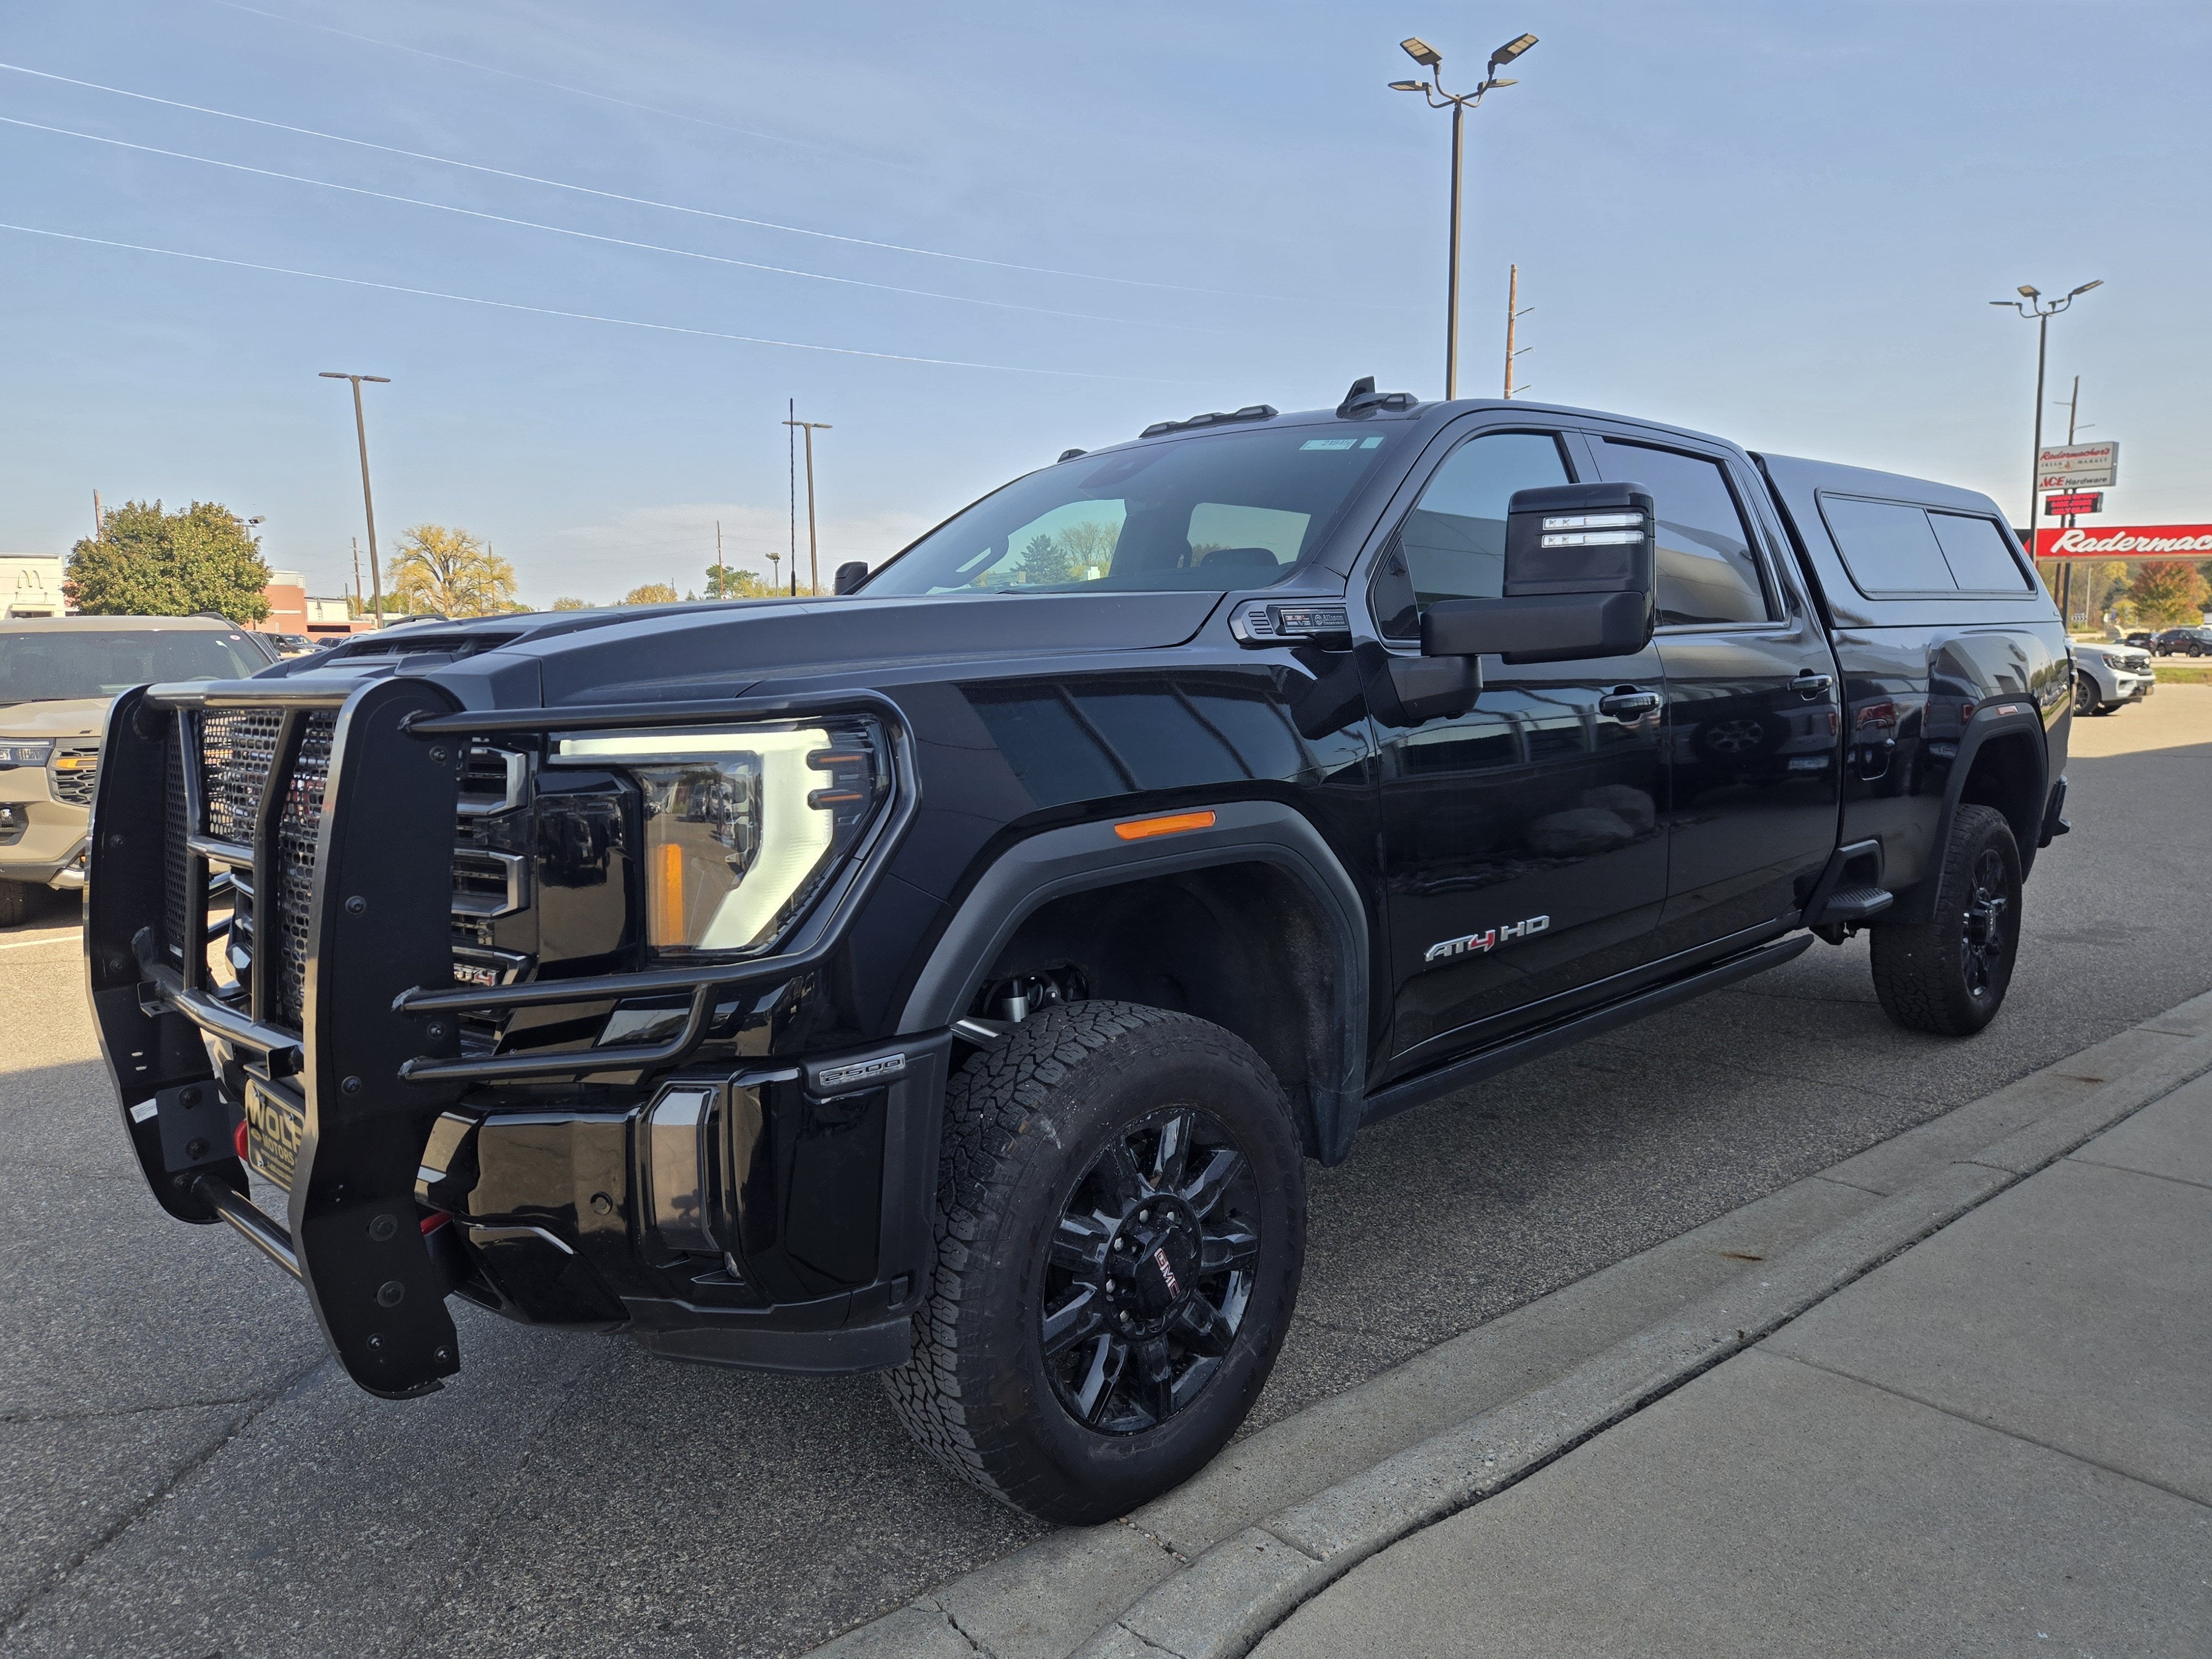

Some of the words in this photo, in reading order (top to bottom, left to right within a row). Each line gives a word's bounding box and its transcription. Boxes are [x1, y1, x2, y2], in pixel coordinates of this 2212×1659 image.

[2040, 447, 2110, 461] Radermacher's
[2039, 476, 2065, 487] ACE
[2065, 477, 2107, 486] Hardware
[1425, 929, 1495, 962] AT4
[1500, 915, 1550, 941] HD
[825, 1059, 901, 1082] 2500
[248, 1087, 302, 1154] WOLF
[262, 1133, 295, 1166] MOTORS
[1154, 1248, 1181, 1300] GMC
